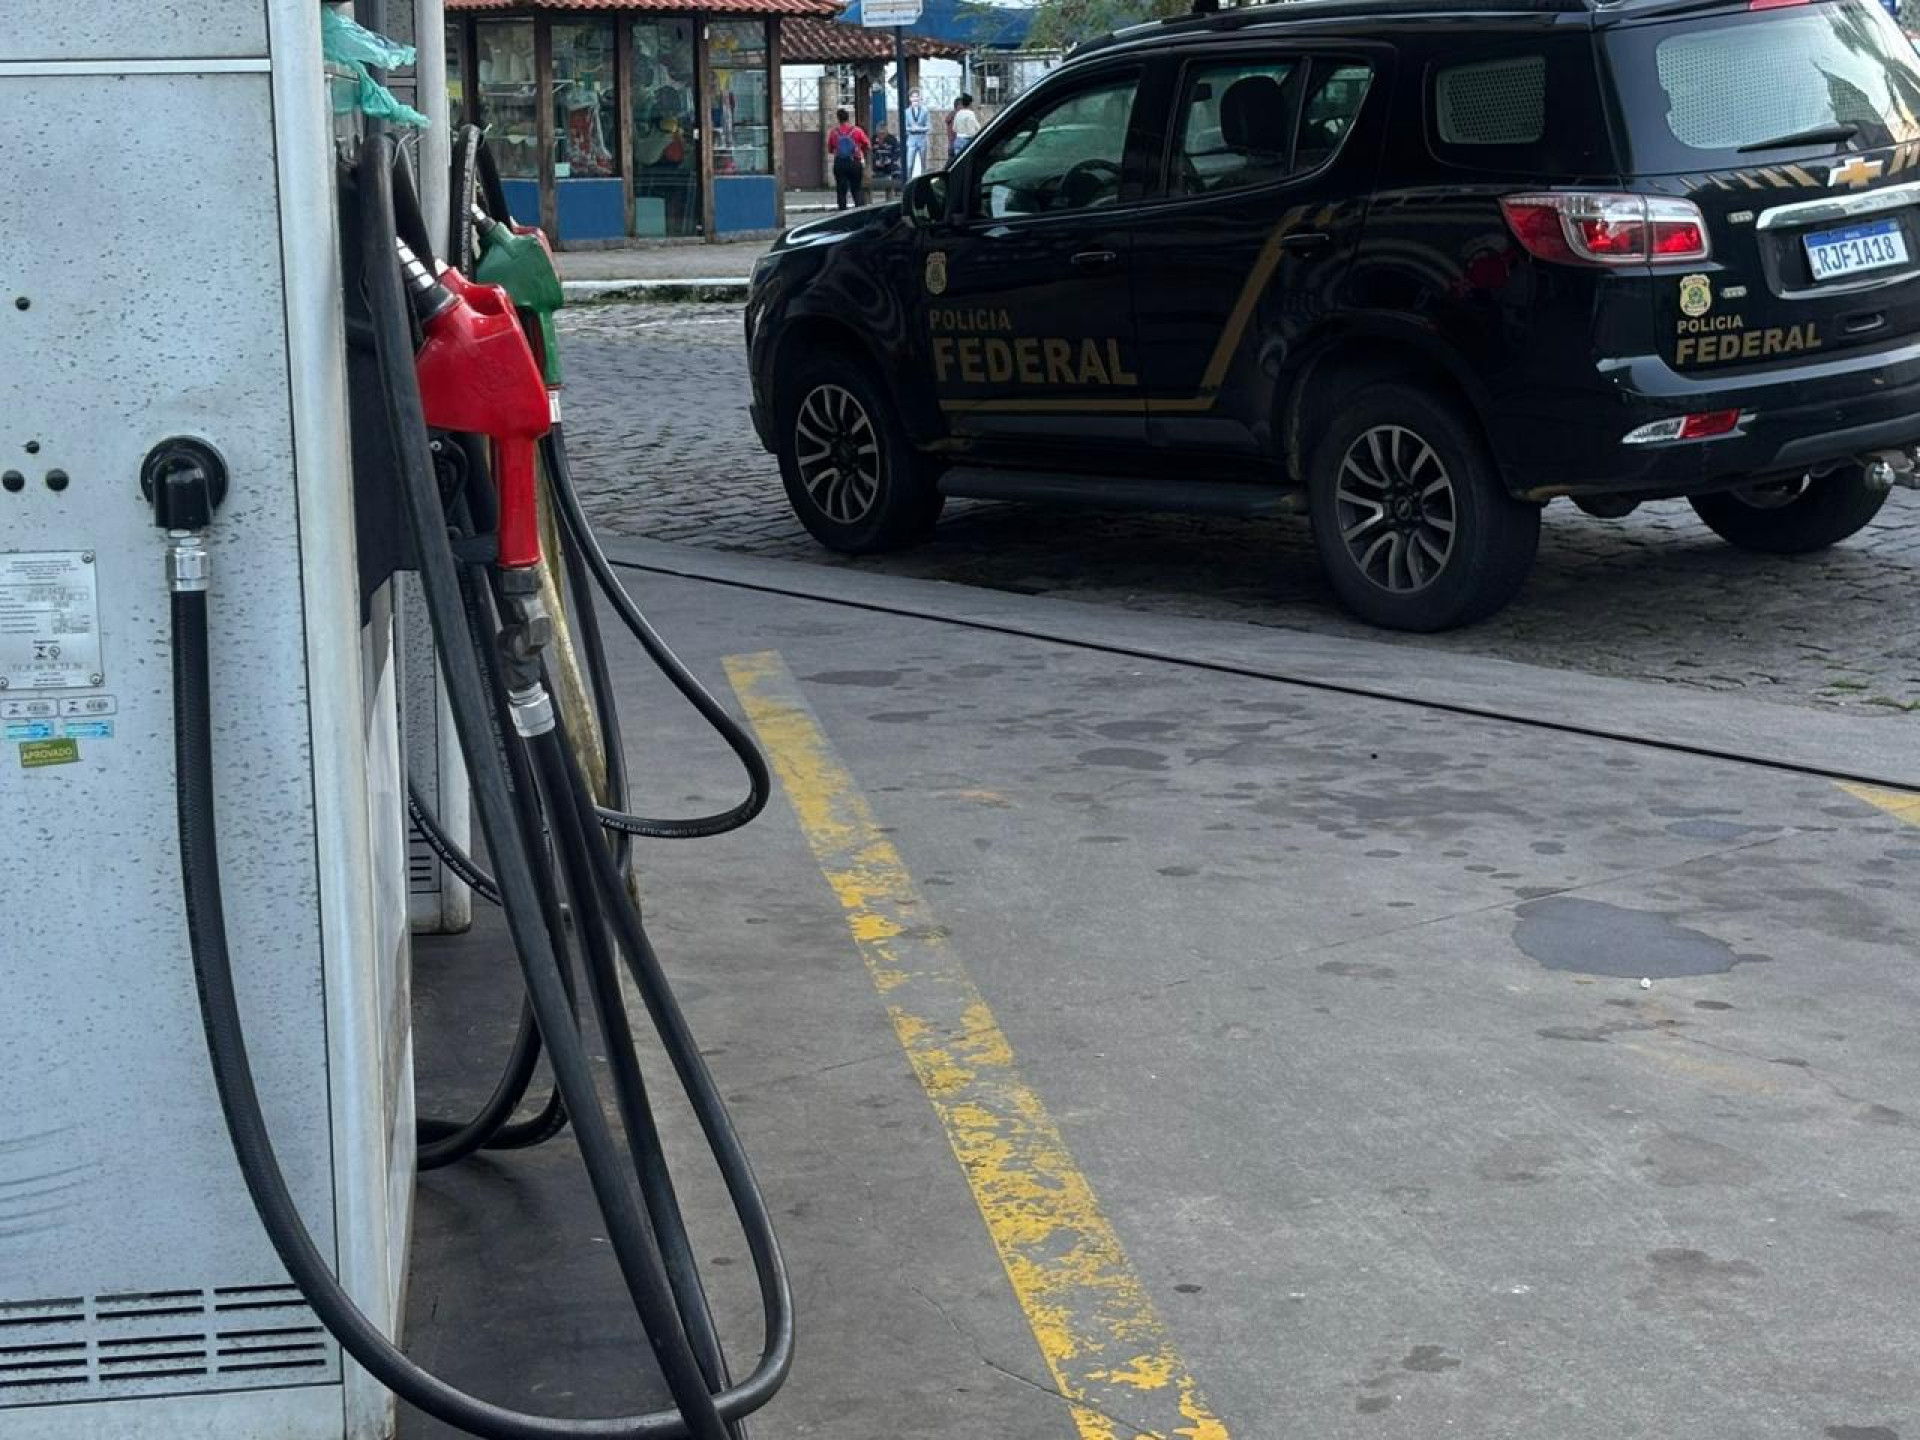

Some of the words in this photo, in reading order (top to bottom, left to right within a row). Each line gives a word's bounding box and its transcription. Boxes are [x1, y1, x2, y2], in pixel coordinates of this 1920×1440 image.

[1817, 236, 1897, 273] RJF1A18
[929, 308, 1012, 331] POLICIA
[1677, 314, 1744, 334] POLICIA
[932, 338, 1138, 385] FEDERAL
[1676, 323, 1822, 366] FEDERAL
